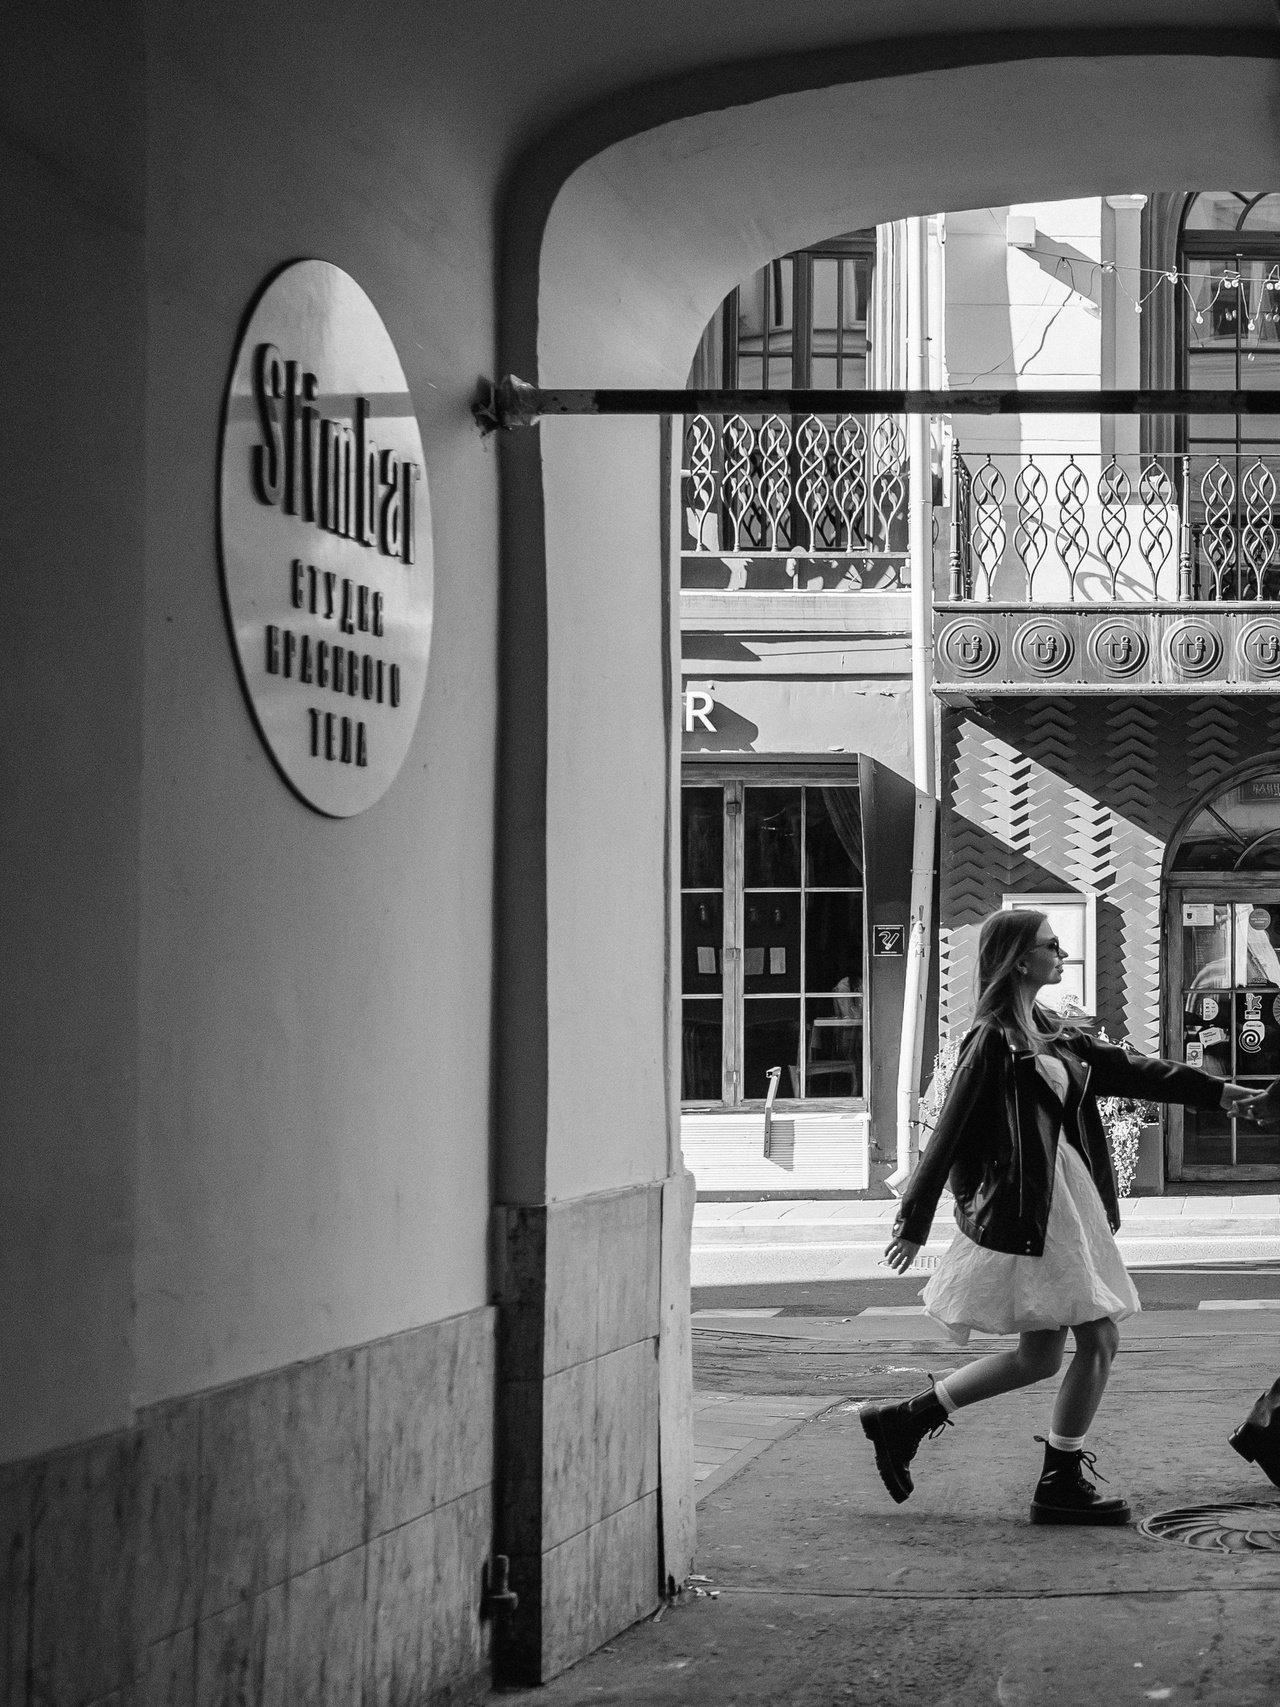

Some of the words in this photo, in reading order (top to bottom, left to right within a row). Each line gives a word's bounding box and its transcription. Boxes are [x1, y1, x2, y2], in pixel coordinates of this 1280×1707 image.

[252, 343, 421, 564] Slimbar
[291, 558, 384, 637] СТУДИЯ
[265, 624, 400, 708] КРАСИВОГО
[308, 707, 368, 767] ТЕЛА
